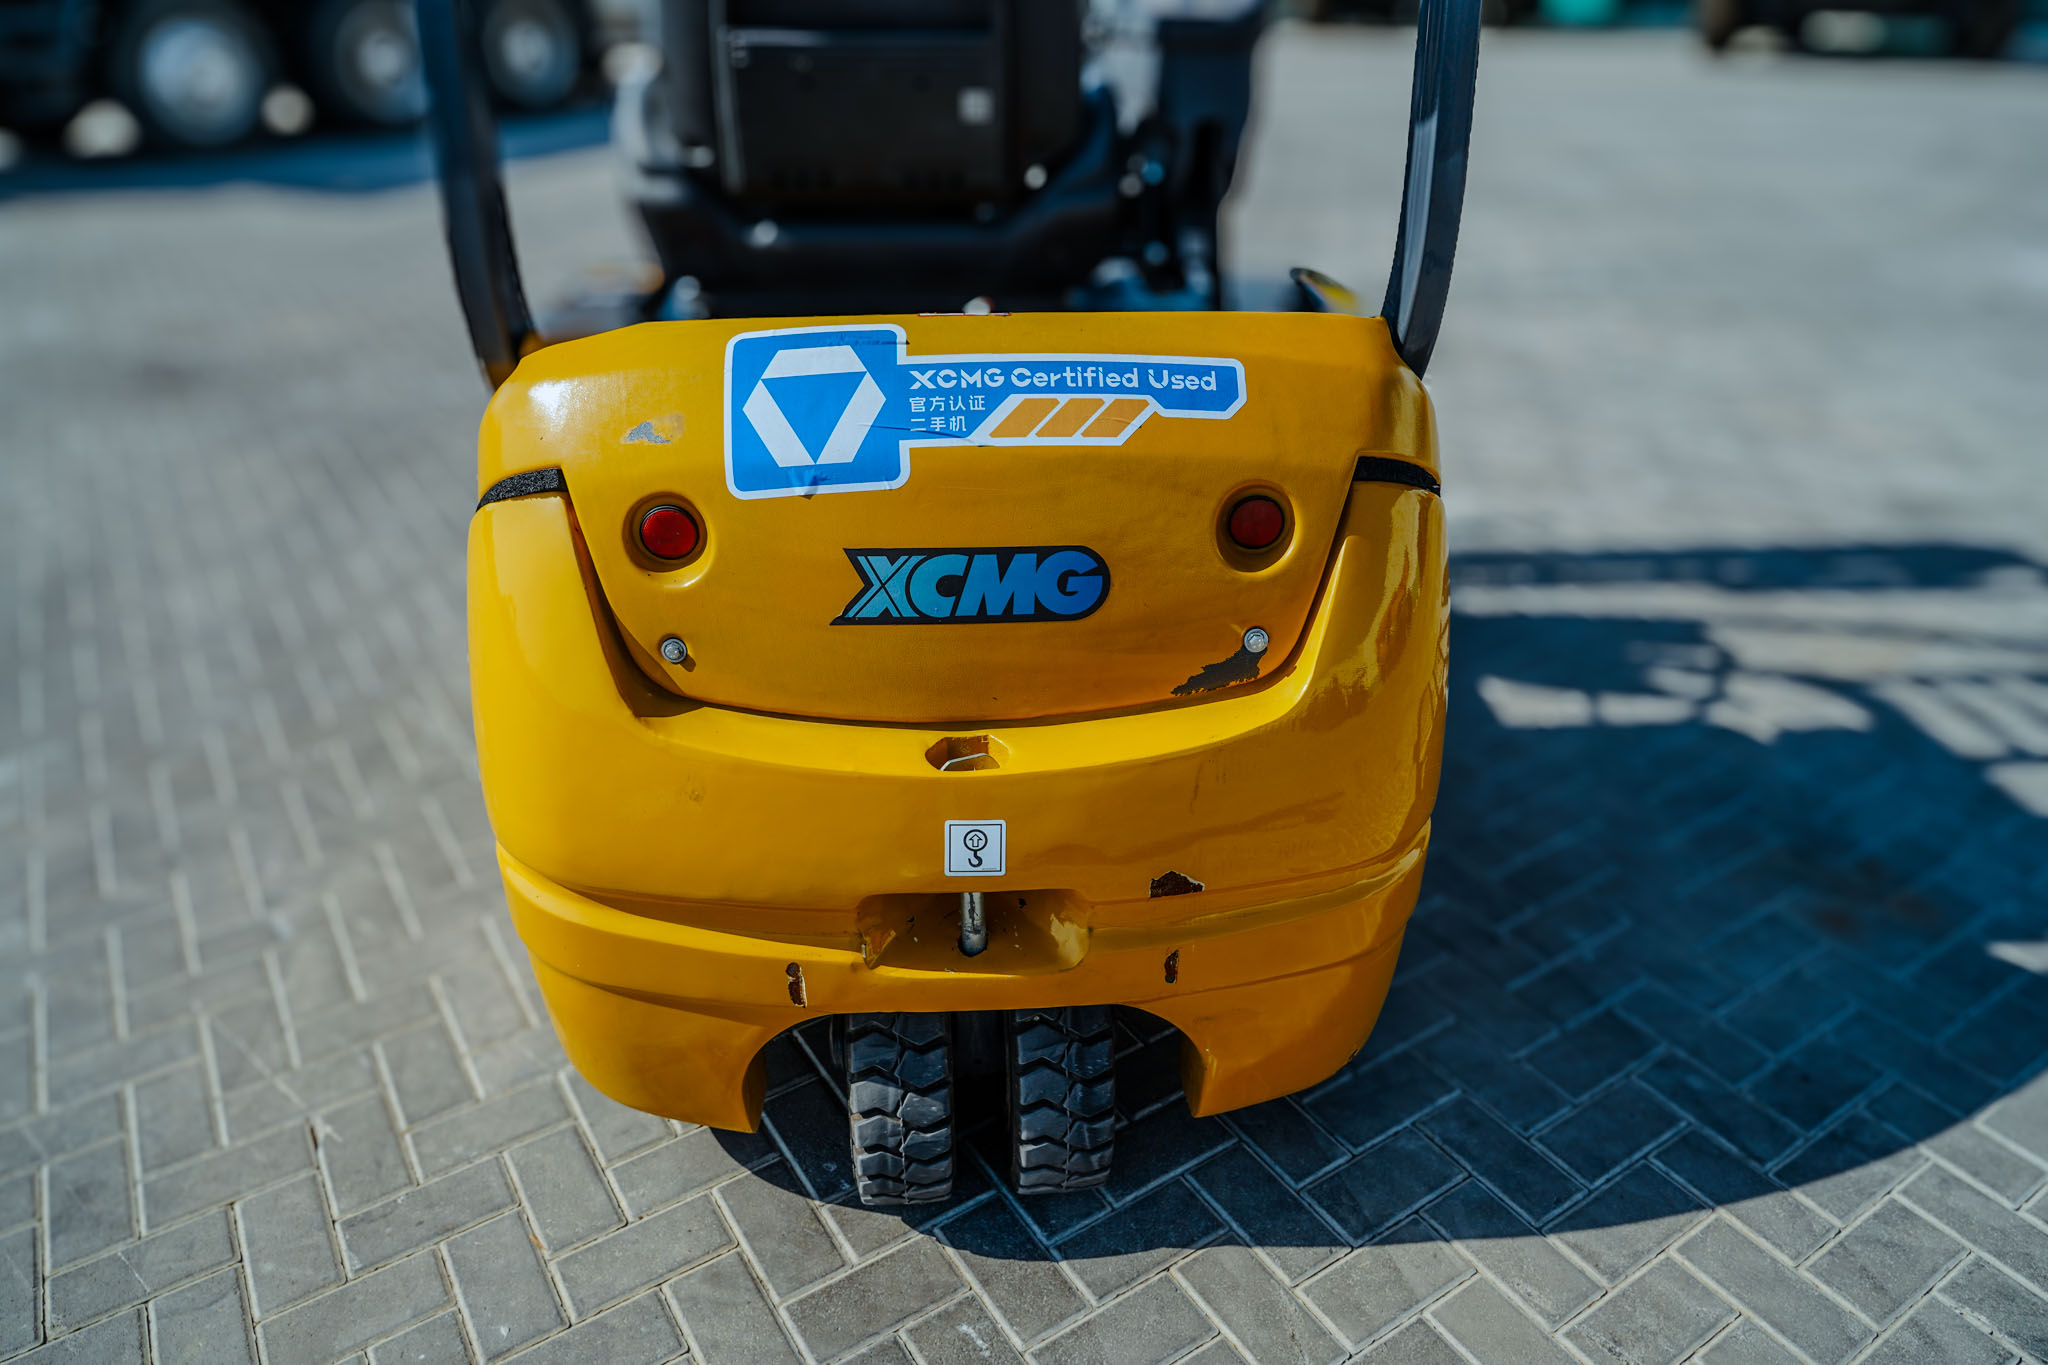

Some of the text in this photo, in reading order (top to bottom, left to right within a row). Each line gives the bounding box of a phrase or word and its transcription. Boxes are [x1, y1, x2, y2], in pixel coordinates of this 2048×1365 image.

[909, 366, 1217, 391] XCMG Certified Used
[909, 395, 986, 413] 官方认证
[910, 415, 967, 432] 二手机
[844, 550, 1103, 618] XCMG
